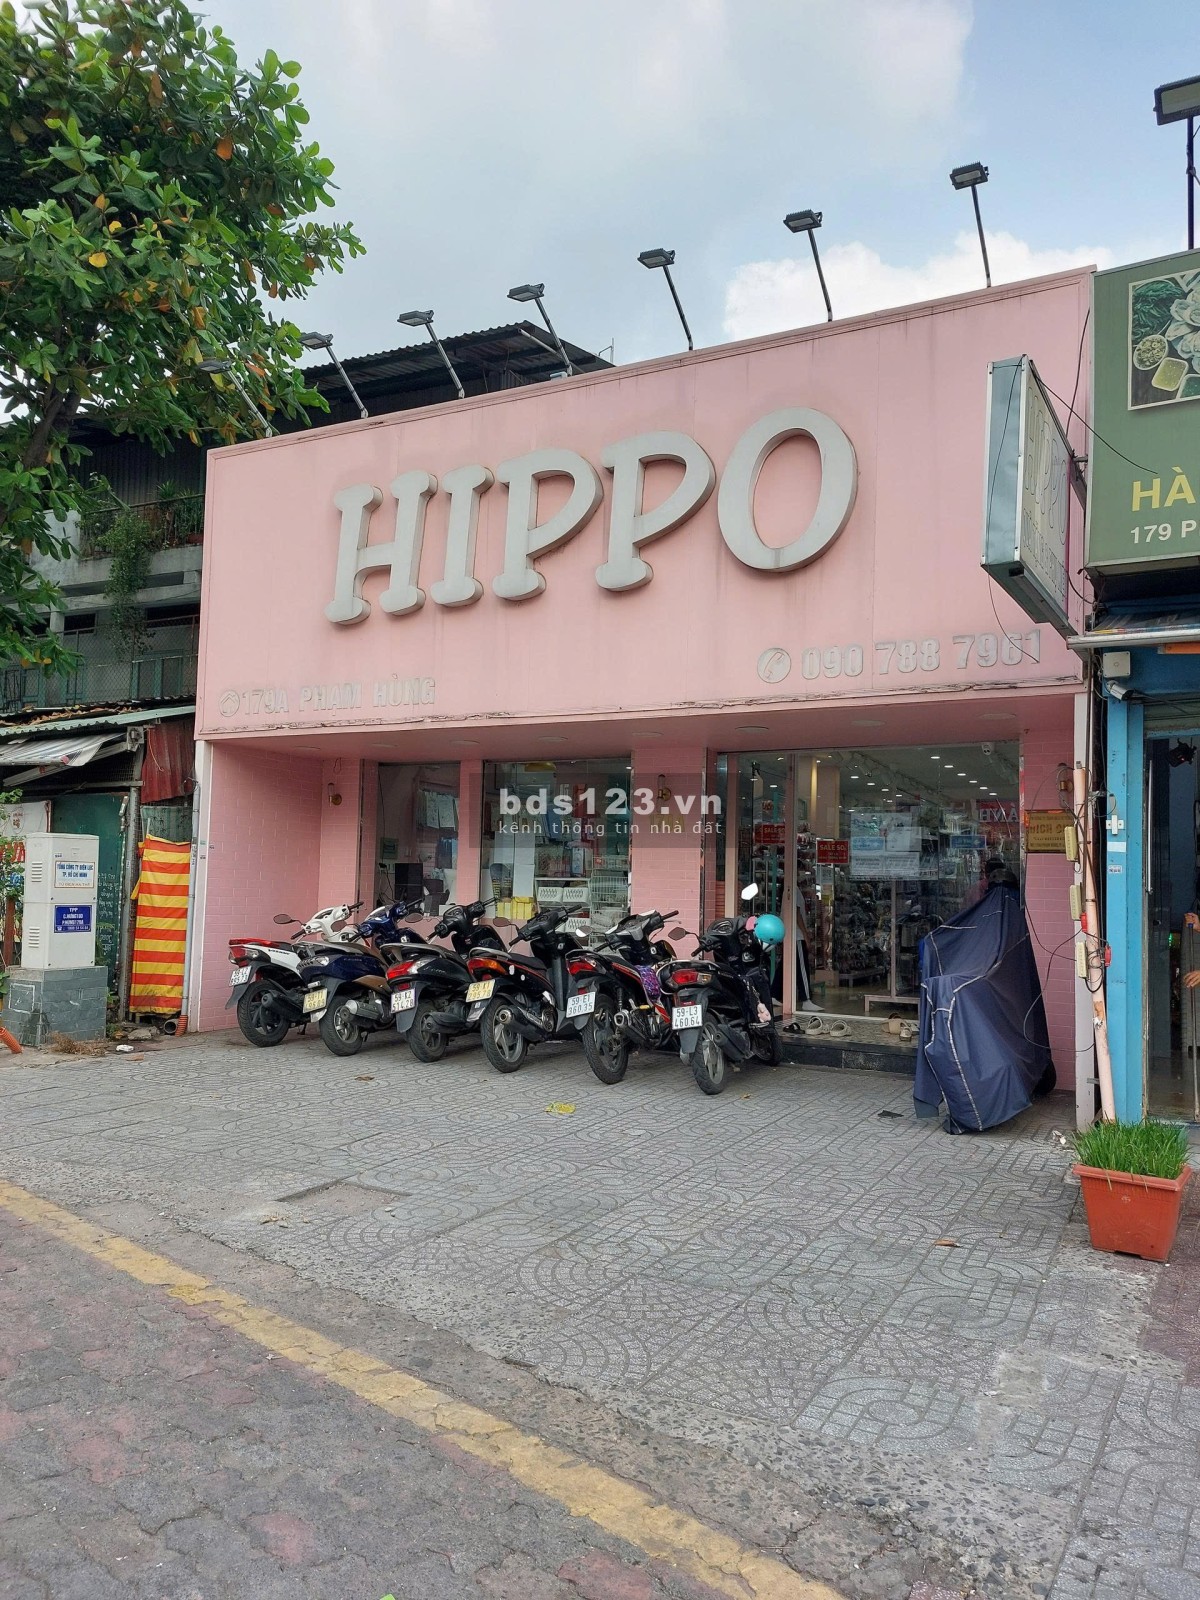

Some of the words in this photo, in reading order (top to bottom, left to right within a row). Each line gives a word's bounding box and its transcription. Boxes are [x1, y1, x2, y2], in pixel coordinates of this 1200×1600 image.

[1131, 466, 1197, 512] HÀ
[325, 406, 859, 625] HIPPO
[1130, 523, 1172, 544] 179
[1181, 519, 1200, 538] P
[801, 643, 864, 680] 090
[875, 637, 940, 675] 788
[953, 628, 1041, 670] 7961
[242, 687, 289, 715] 179A
[298, 682, 362, 716] PHẠM
[373, 673, 436, 707] HÙNG
[568, 1002, 592, 1016] 360.35
[674, 1016, 699, 1027] 460.64
[676, 1006, 697, 1017] 59-L3
